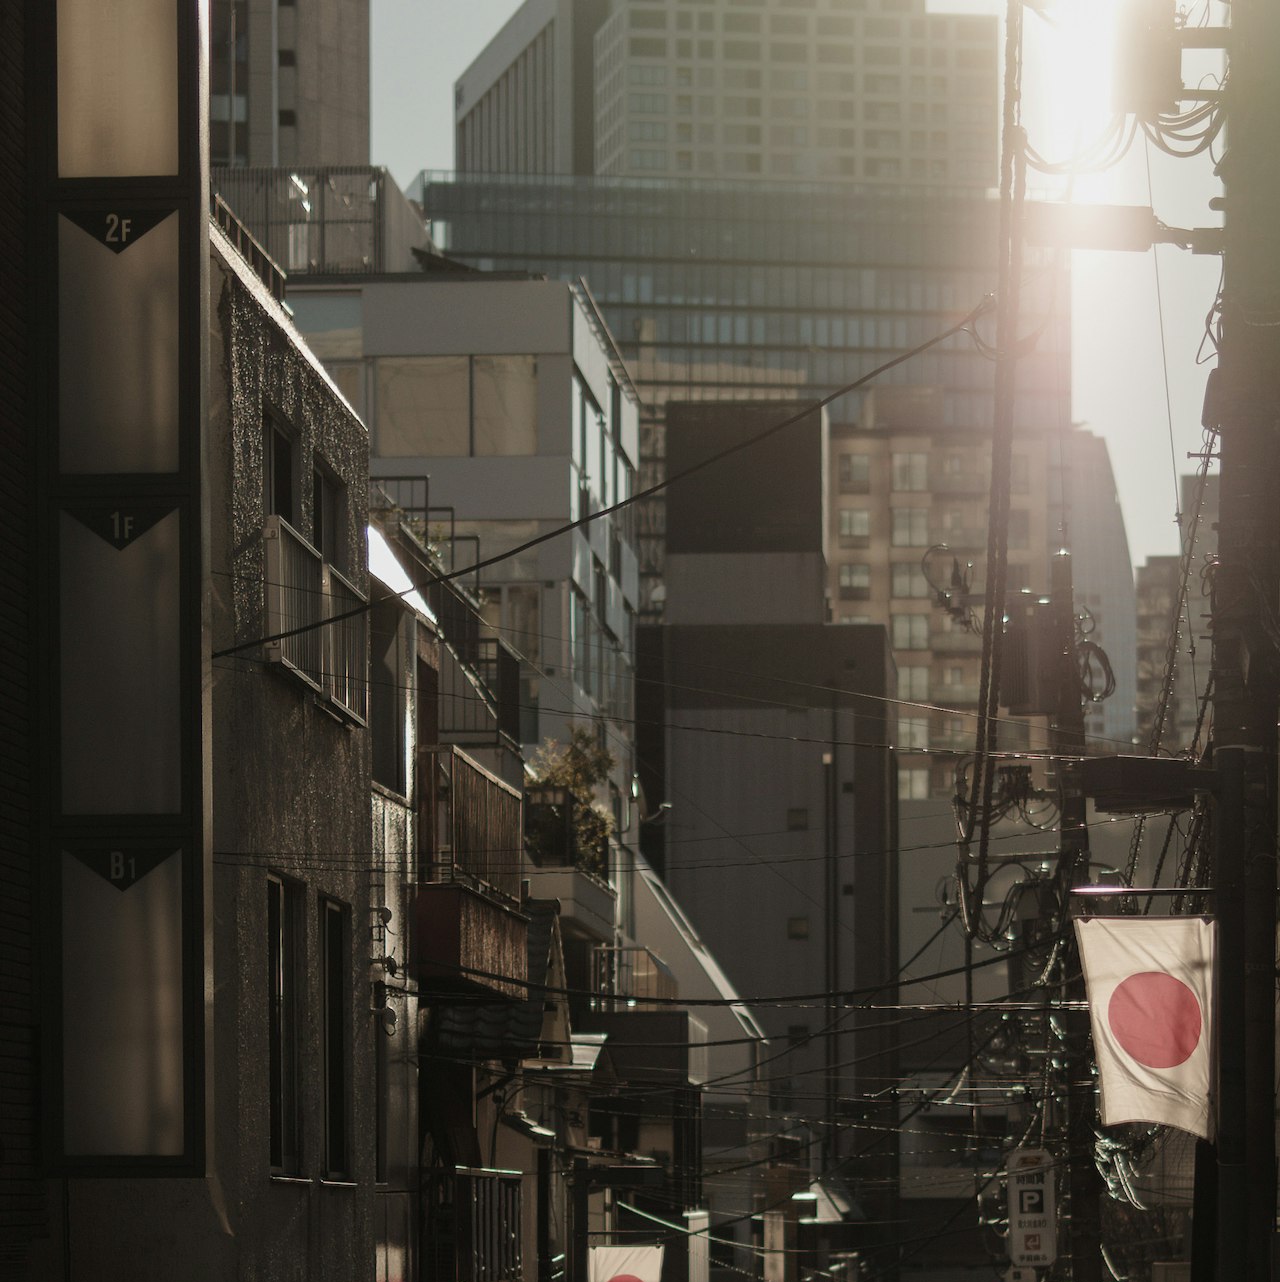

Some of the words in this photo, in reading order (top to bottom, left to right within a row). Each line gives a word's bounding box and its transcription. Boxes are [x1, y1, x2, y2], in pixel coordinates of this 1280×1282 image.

[105, 212, 132, 243] 2F
[109, 511, 135, 539] 1F
[110, 850, 136, 880] B1
[1023, 1192, 1040, 1212] P
